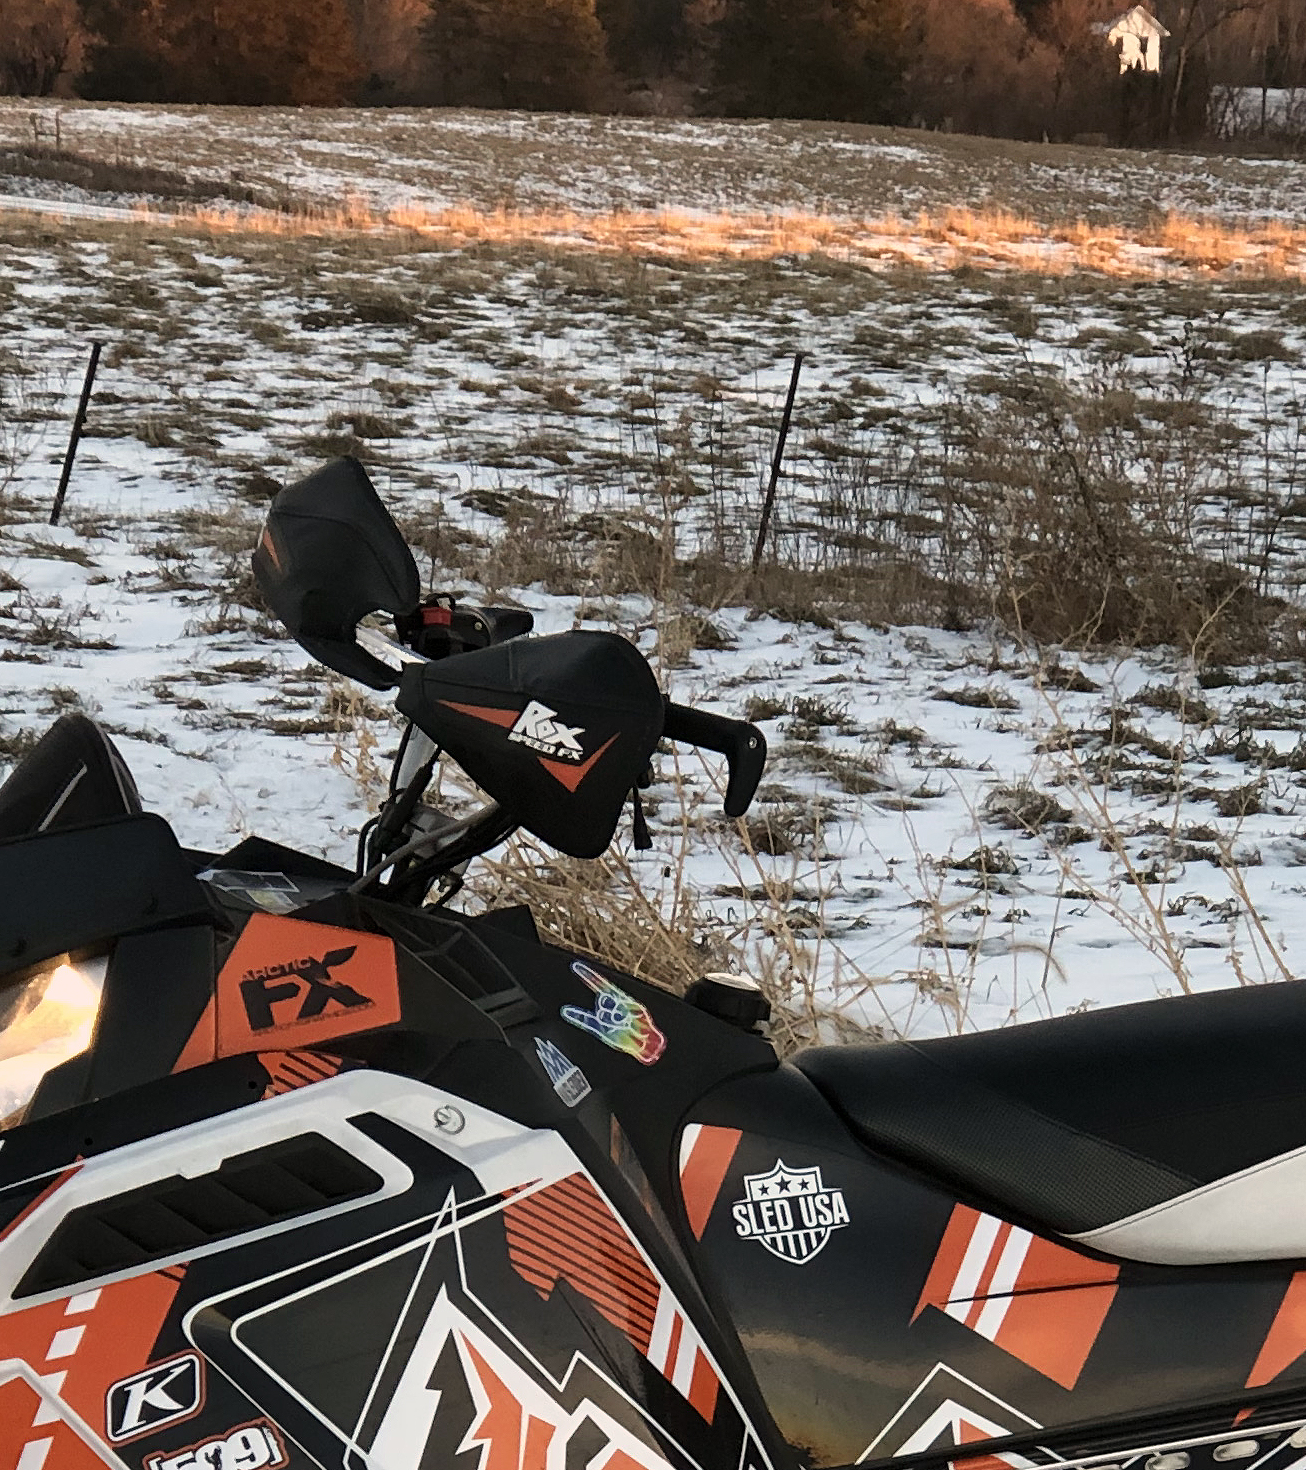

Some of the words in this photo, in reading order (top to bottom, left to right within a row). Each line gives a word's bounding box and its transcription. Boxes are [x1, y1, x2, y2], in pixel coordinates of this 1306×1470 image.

[513, 700, 585, 750] ROX
[239, 945, 373, 1031] FX
[243, 956, 311, 981] ARCTIC
[732, 1199, 794, 1236] SLED
[799, 1192, 850, 1228] USA
